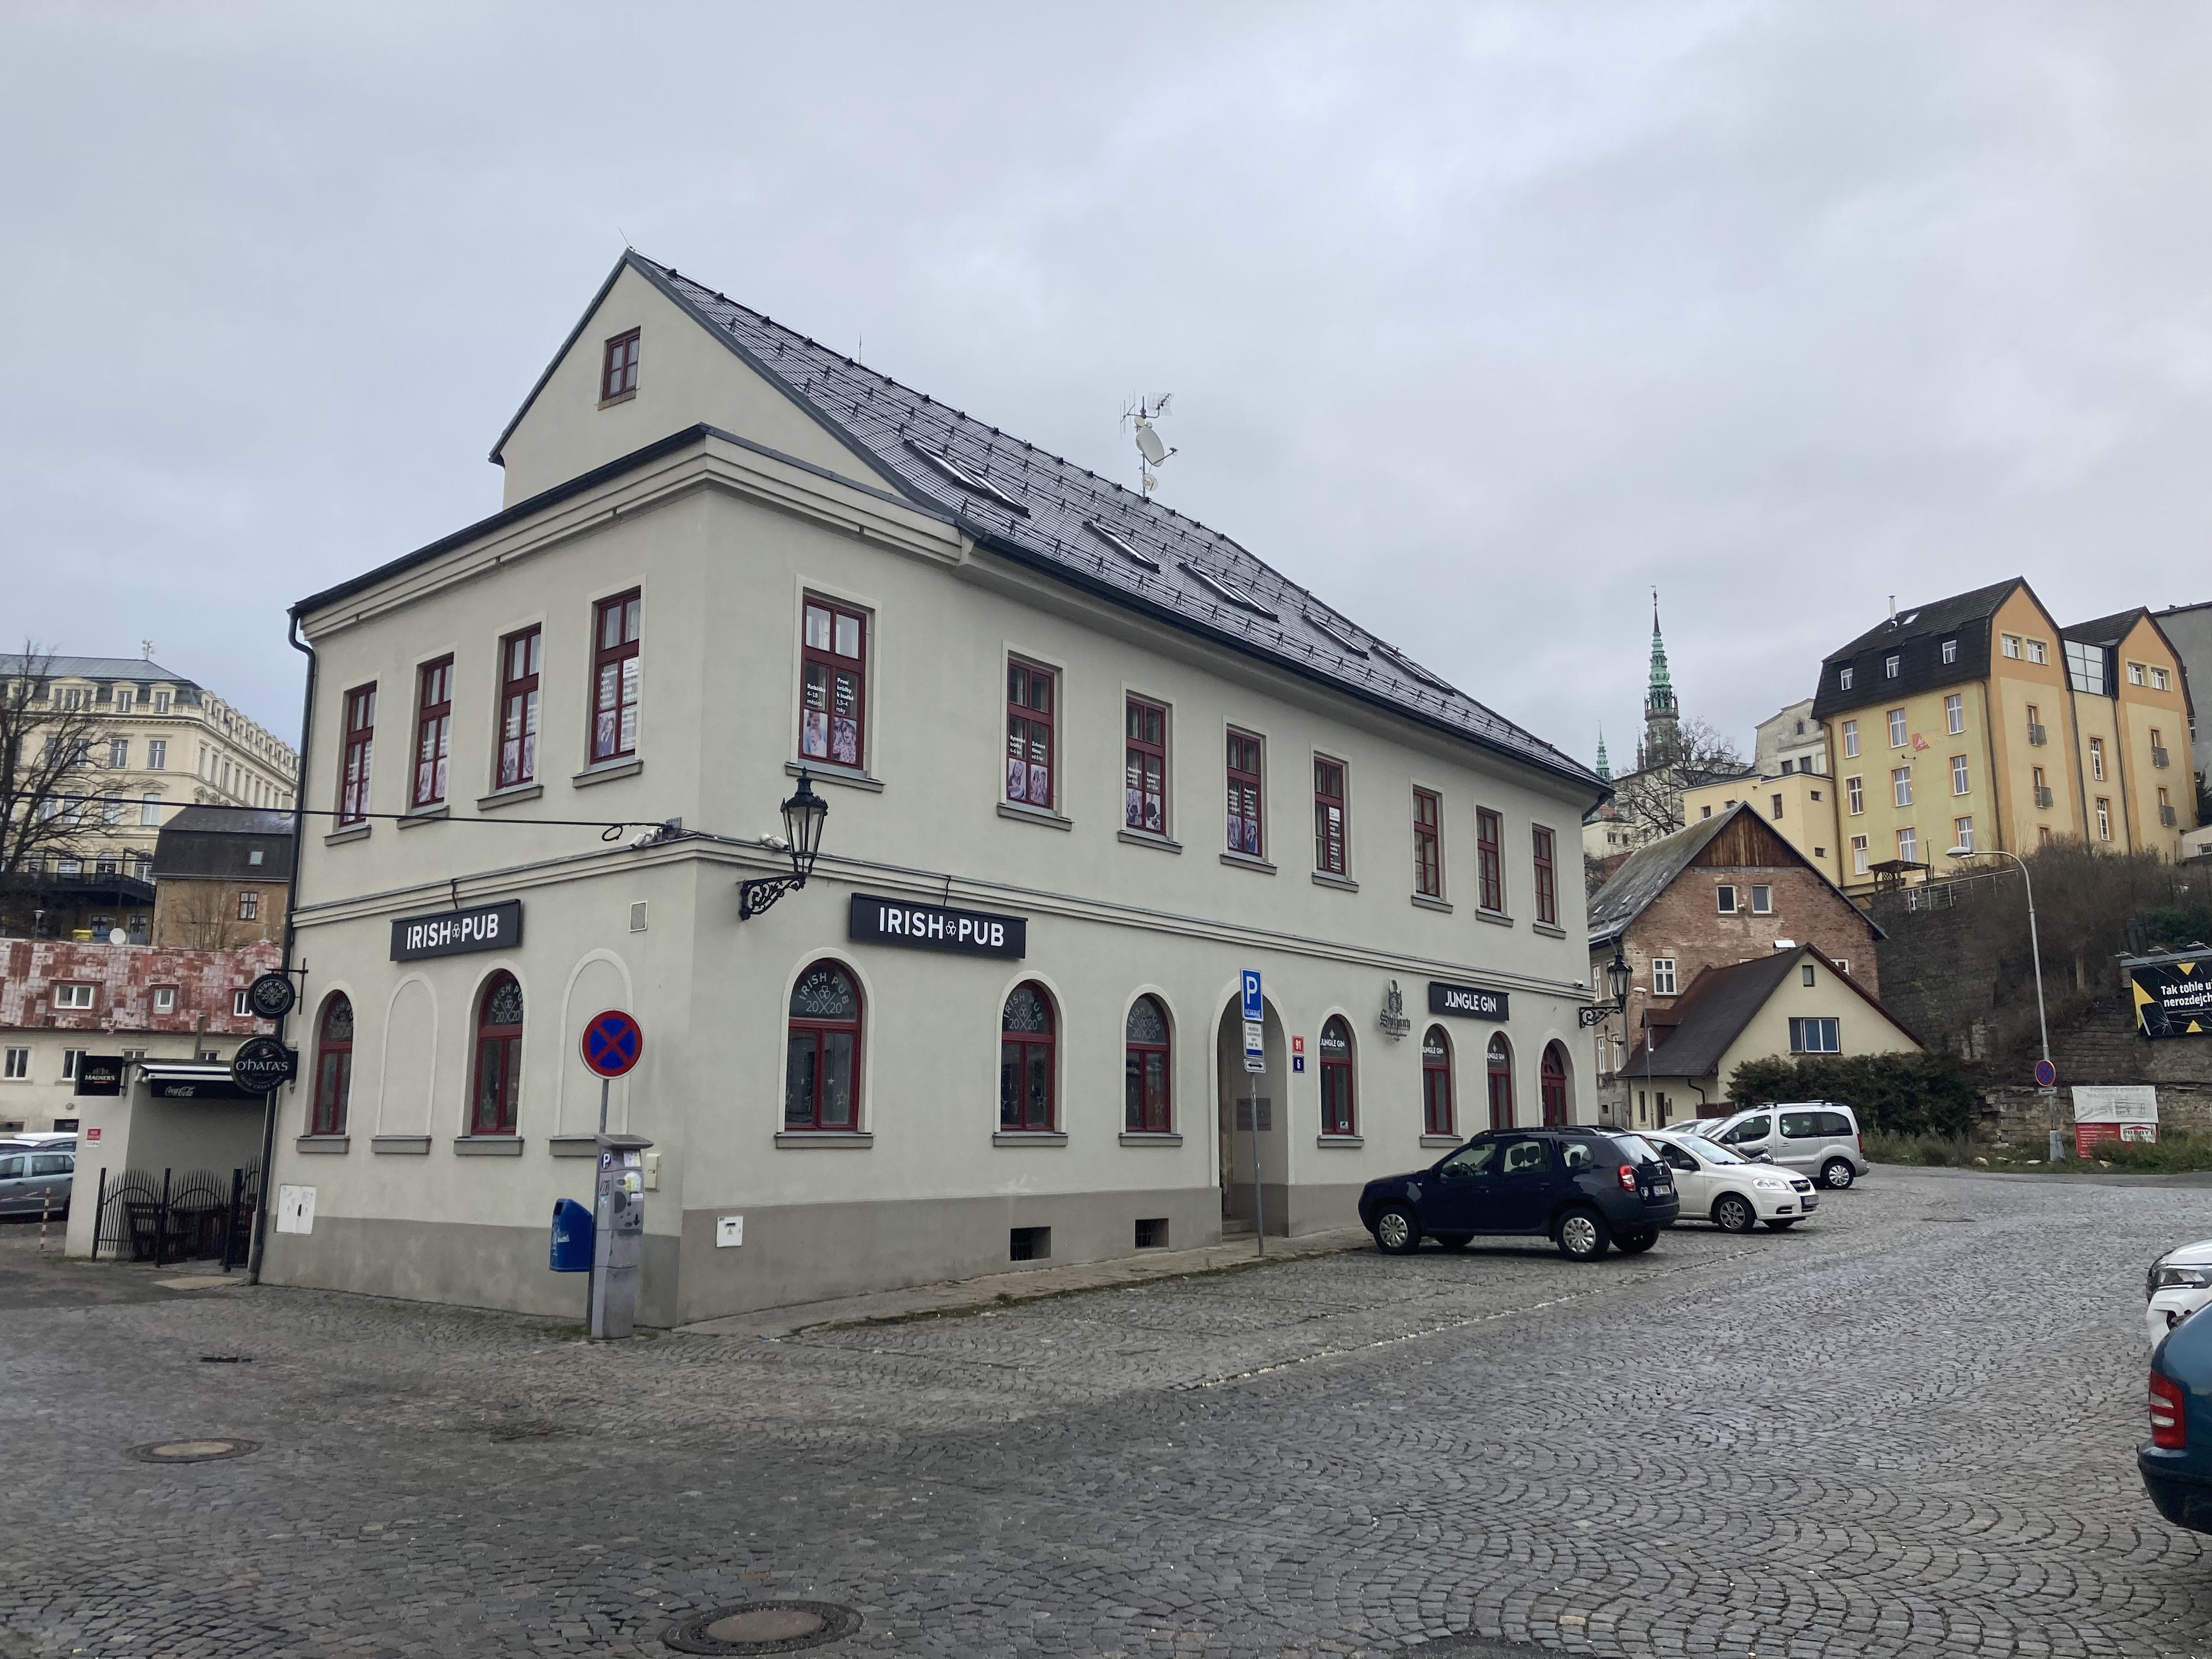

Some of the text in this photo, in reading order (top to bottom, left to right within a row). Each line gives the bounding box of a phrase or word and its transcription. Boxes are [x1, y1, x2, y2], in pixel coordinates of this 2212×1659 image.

[624, 692, 638, 702] RADOS
[406, 914, 498, 950] IRISH PUB
[879, 907, 1004, 947] IRISH PUB
[257, 982, 286, 995] IRISH PUB
[799, 972, 849, 1004] IRISH PUB
[1246, 976, 1258, 1004] P
[2161, 984, 2178, 995] Tak
[2179, 981, 2204, 994] tohle
[492, 983, 510, 1012] IRISH
[1445, 990, 1496, 1013] JUNGLE GIN
[2163, 992, 2212, 1007] nerozdejch
[806, 1000, 842, 1014] 20 20
[1004, 993, 1043, 1021] IRISH PUB
[495, 1010, 520, 1022] 20 20
[1128, 1006, 1145, 1028] IRISH
[1009, 1018, 1037, 1030] 20 20
[1133, 1028, 1141, 1037] 20
[1295, 1040, 1301, 1050] 91
[1320, 1039, 1336, 1047] JUNGLE
[1297, 1060, 1301, 1070] 6
